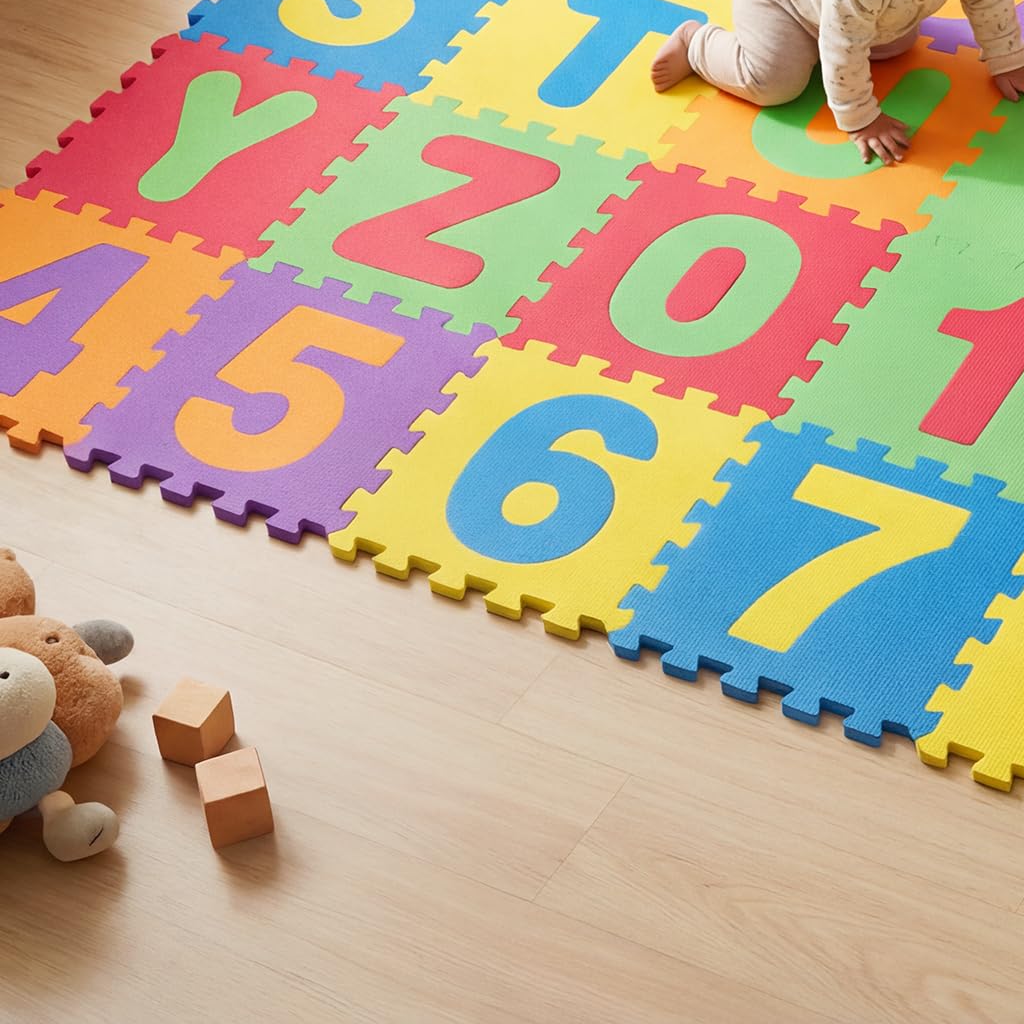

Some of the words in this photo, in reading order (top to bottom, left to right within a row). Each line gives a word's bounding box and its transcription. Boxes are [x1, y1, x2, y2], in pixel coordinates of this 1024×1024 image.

[138, 71, 317, 202] Y
[332, 134, 560, 289] Z
[0, 243, 150, 396] 4
[175, 305, 406, 473] 5
[446, 393, 659, 564] 6
[727, 463, 972, 653] 7
